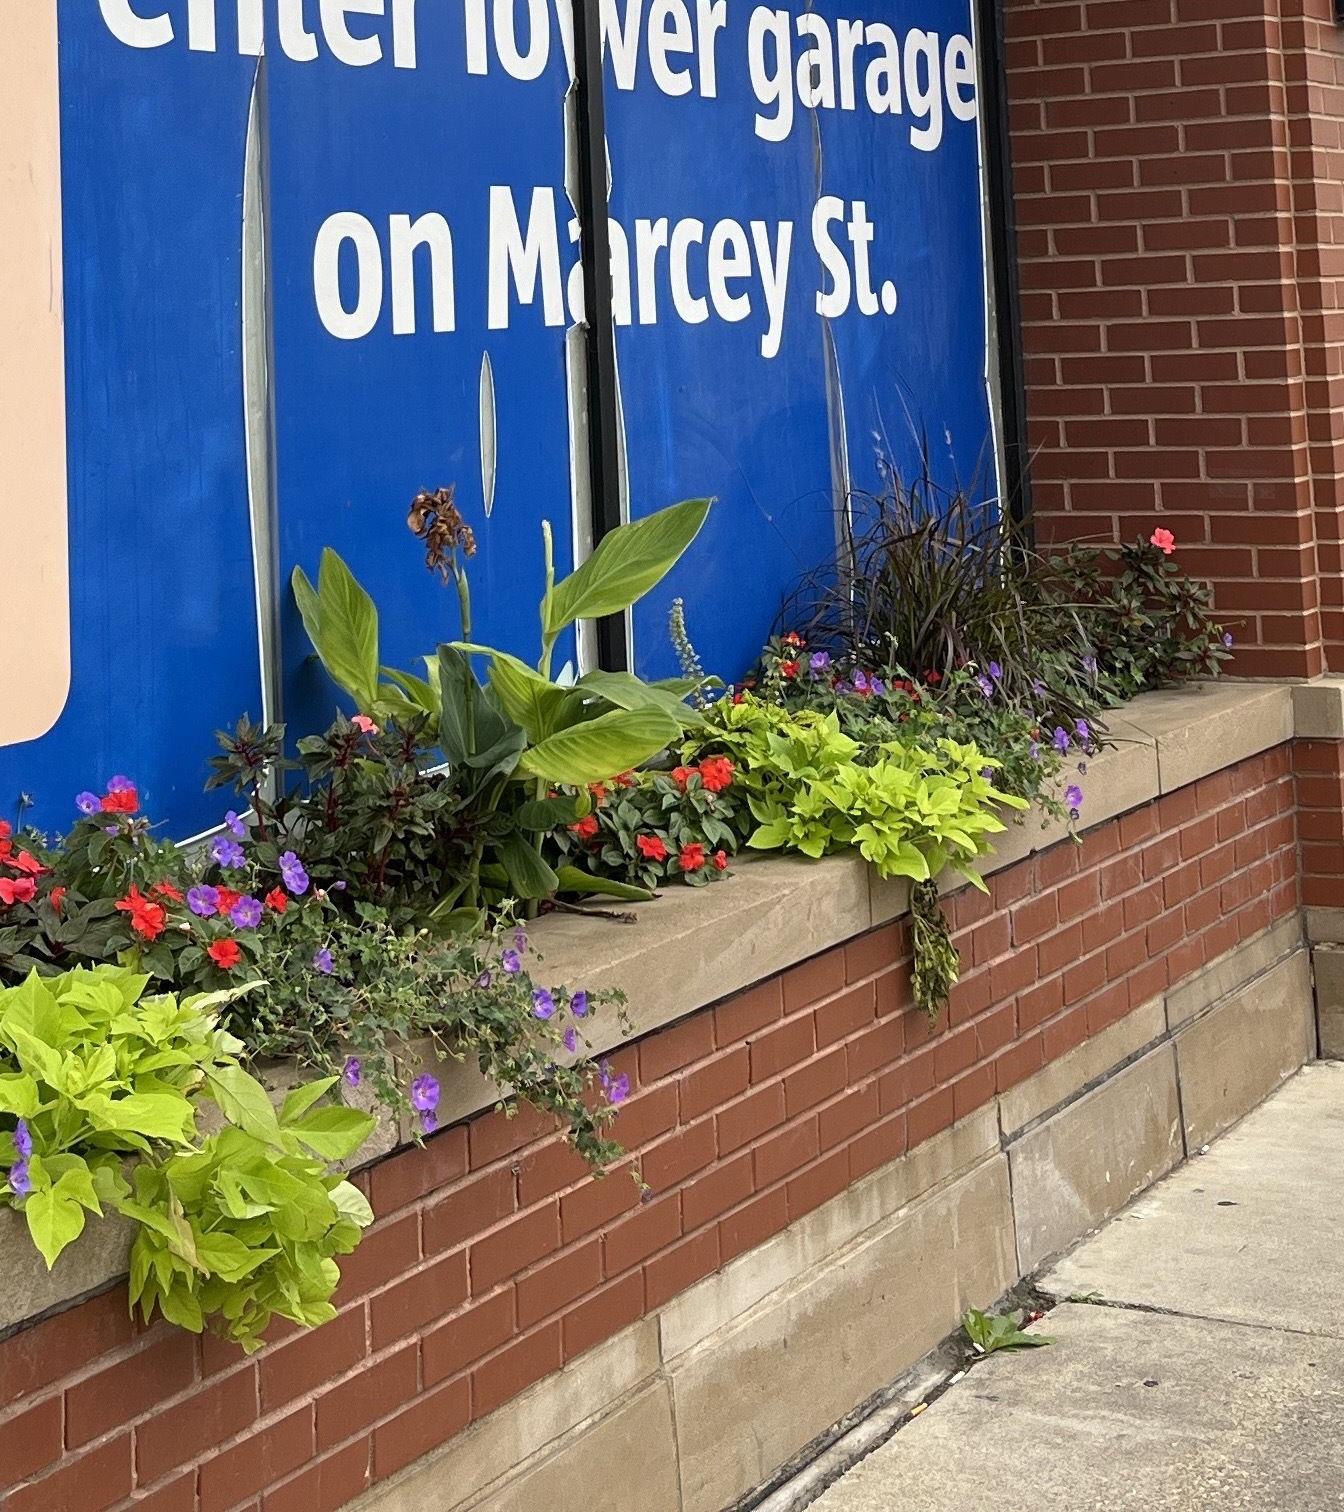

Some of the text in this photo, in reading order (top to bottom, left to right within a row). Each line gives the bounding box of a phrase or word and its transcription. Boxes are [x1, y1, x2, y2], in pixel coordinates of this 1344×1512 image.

[746, 4, 977, 152] garage
[313, 184, 897, 360] on Marcey St.
